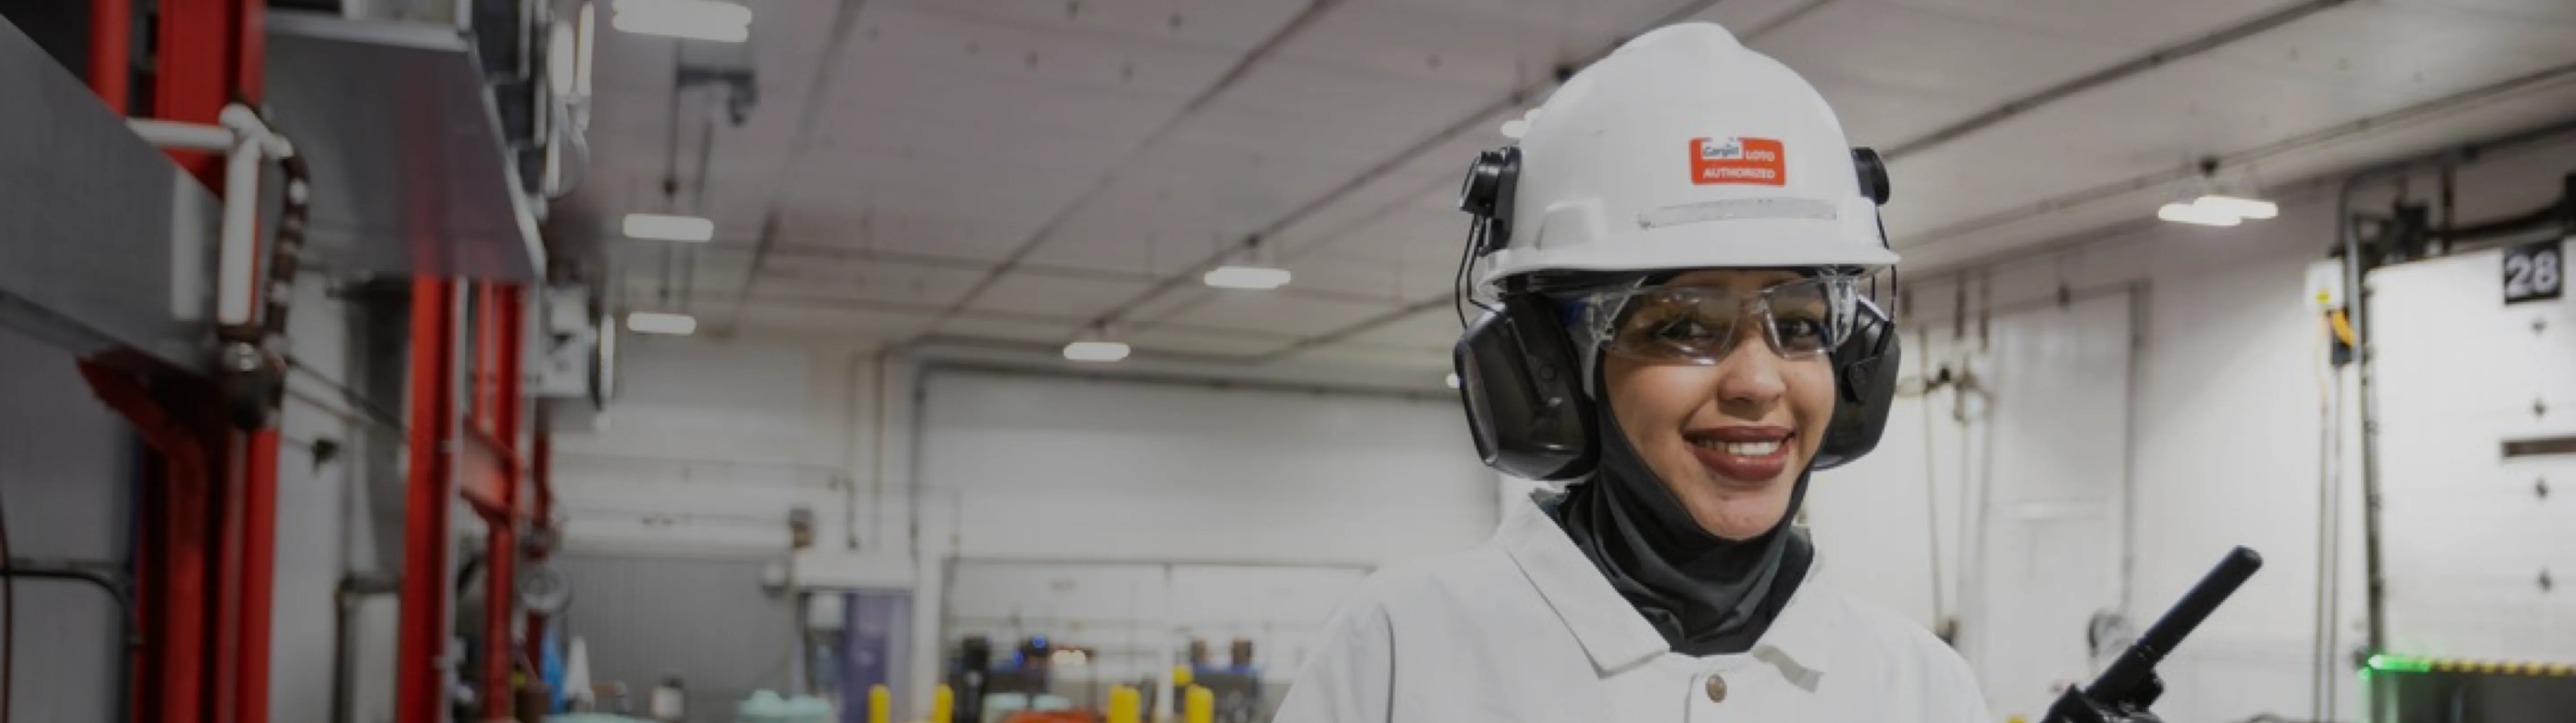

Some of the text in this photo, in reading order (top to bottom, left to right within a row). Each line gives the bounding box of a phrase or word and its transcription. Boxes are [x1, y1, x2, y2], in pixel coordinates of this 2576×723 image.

[1745, 149, 1775, 162] LOTO
[1703, 168, 1776, 179] AUTHORIZED
[2506, 250, 2556, 297] 28
